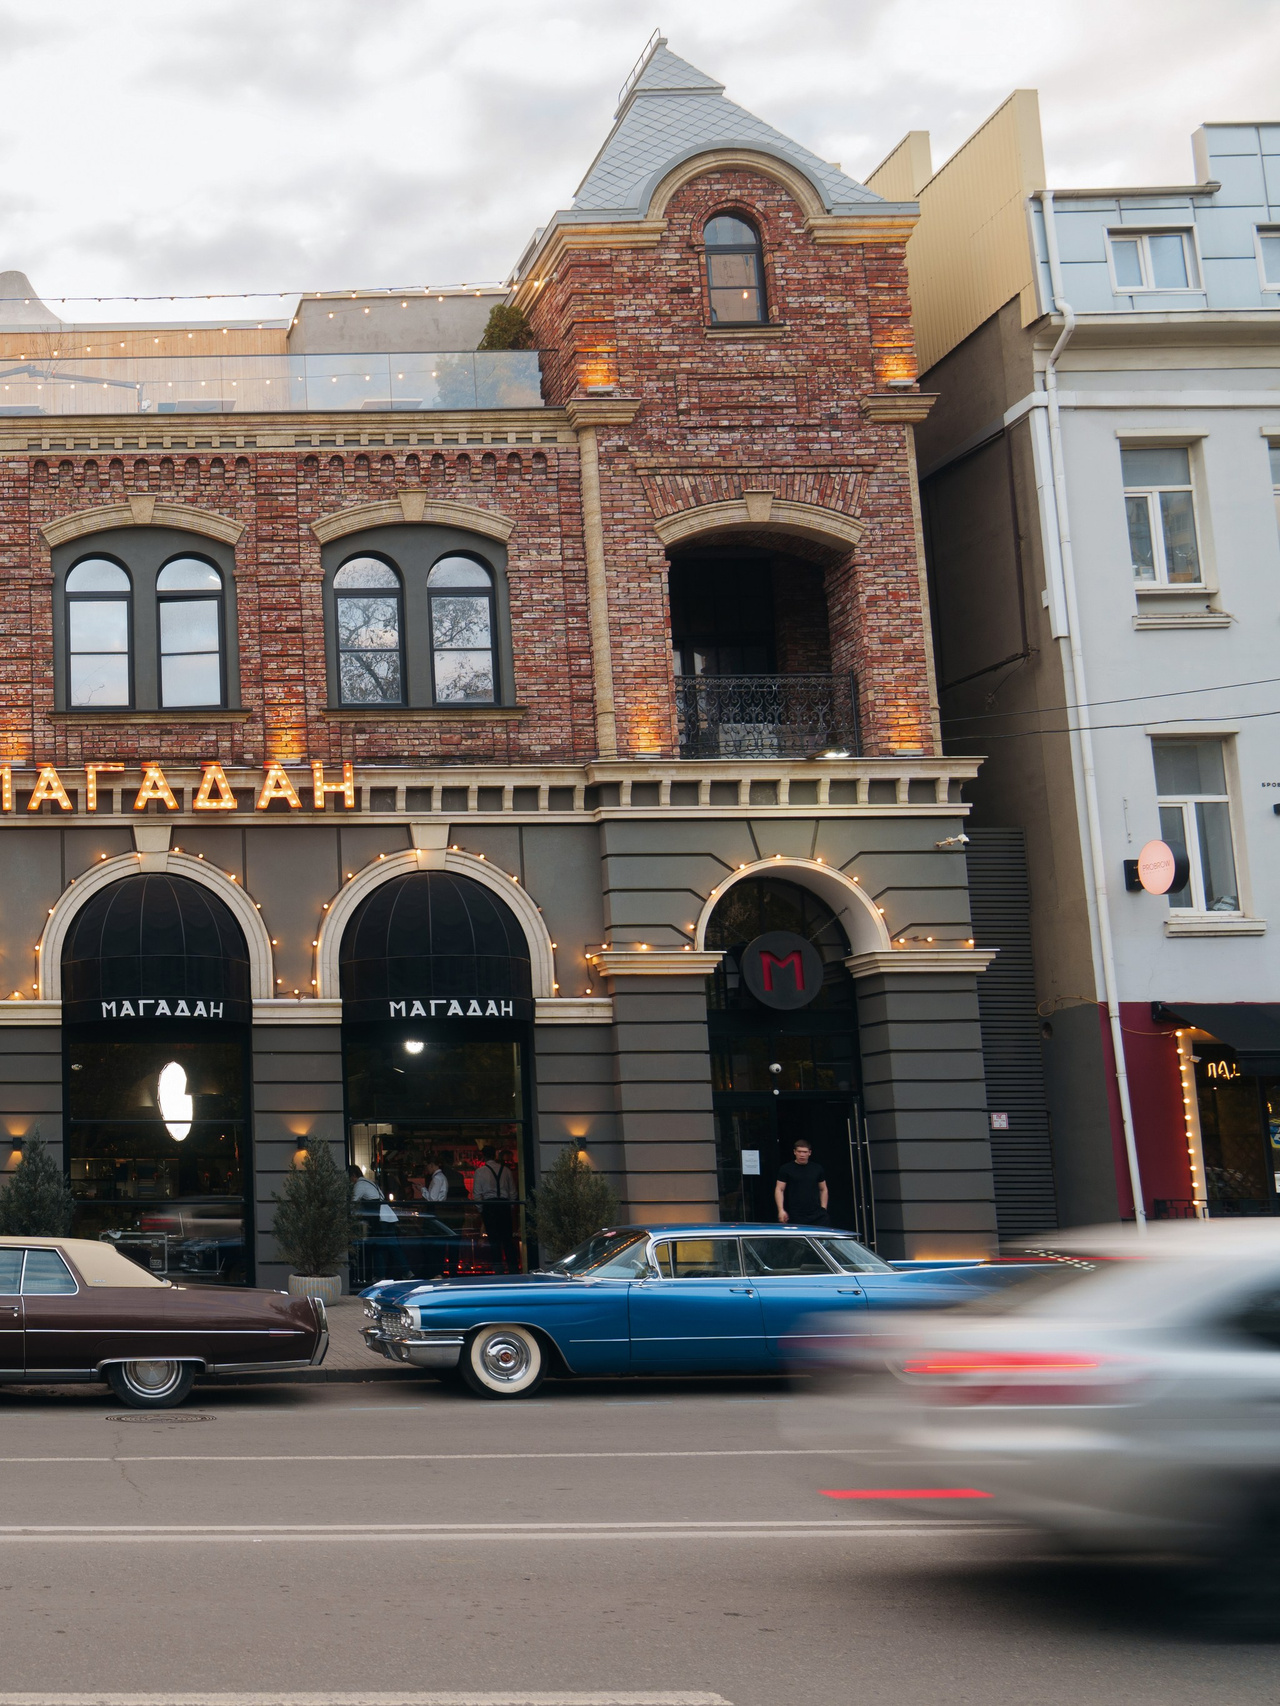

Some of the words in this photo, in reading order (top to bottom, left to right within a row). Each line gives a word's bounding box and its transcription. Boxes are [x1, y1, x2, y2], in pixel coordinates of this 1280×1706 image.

[1142, 860, 1171, 872] PROBROW
[101, 999, 224, 1018] МАГАДАН
[389, 999, 513, 1017] МАГАДАН
